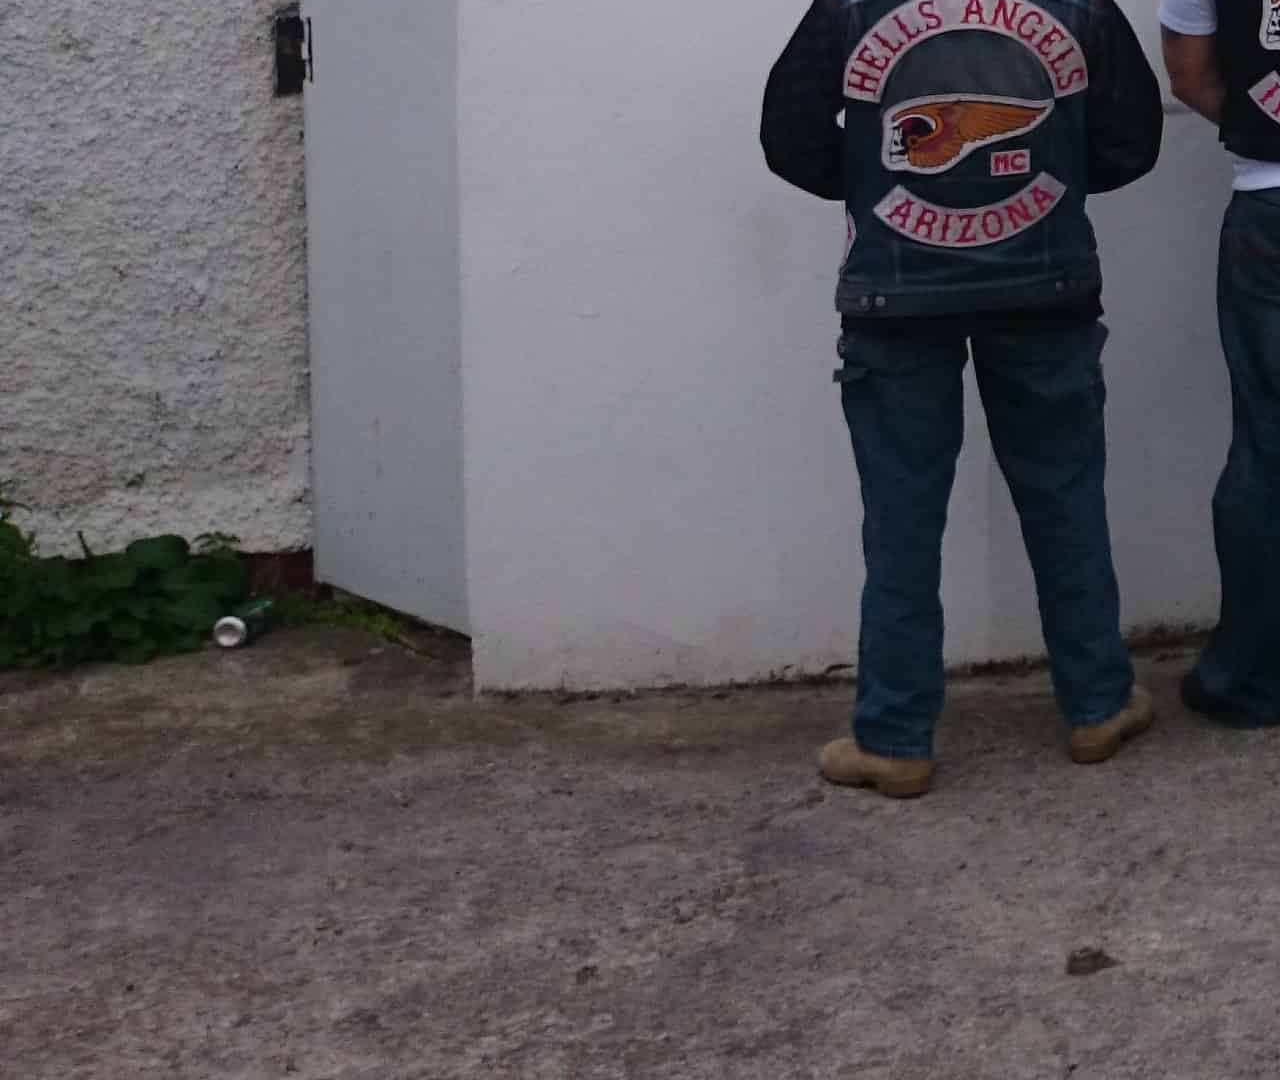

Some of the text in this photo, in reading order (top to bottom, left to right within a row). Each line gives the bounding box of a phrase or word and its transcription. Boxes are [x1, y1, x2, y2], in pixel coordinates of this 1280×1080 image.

[847, 0, 943, 97] HELLS
[993, 152, 1027, 172] MC
[887, 184, 1058, 243] ARIZONA
